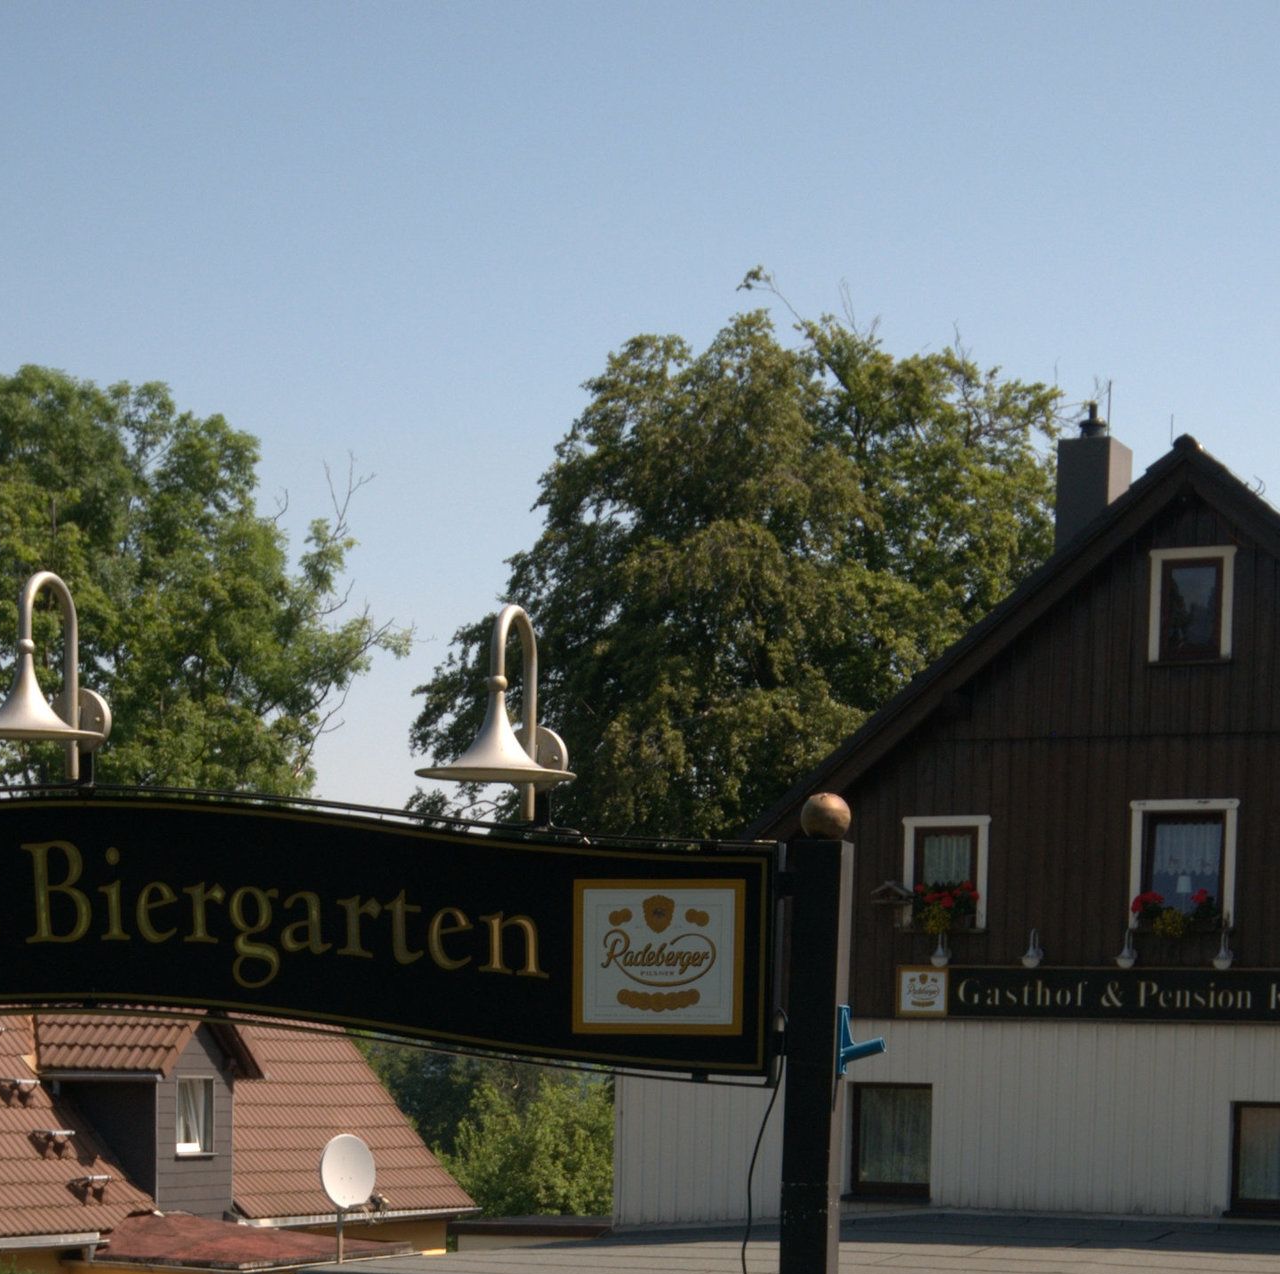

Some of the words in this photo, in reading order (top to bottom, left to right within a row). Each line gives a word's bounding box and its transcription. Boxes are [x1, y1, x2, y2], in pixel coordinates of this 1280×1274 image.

[20, 839, 550, 989] Biergarten
[601, 928, 716, 982] Radeberger
[957, 977, 1089, 1006] Gasthof
[1101, 980, 1124, 1008] &
[1138, 981, 1252, 1009] Pension
